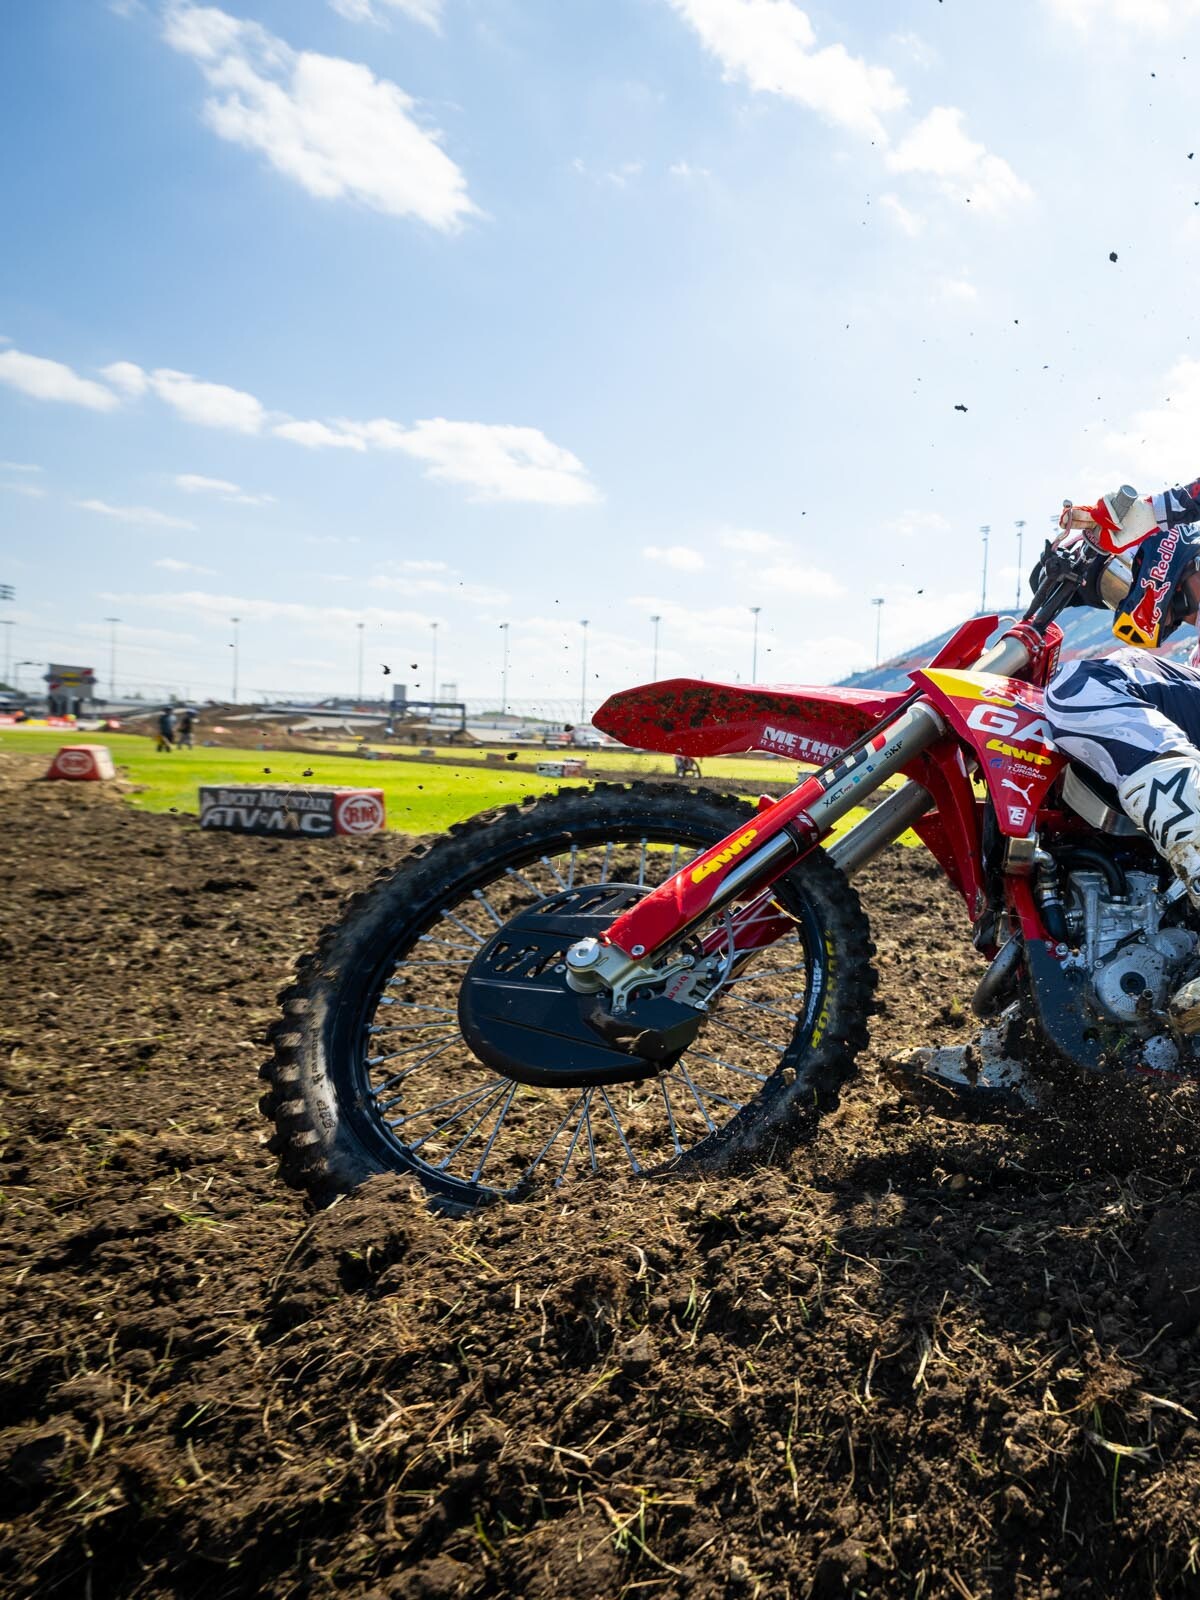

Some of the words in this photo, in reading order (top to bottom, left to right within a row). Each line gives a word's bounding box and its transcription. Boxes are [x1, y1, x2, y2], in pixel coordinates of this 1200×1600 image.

[1149, 547, 1175, 582] Red
[762, 726, 846, 759] METHO
[884, 741, 903, 759] SKF
[1008, 765, 1048, 781] TURISMO
[1014, 763, 1041, 774] GRAN
[823, 788, 845, 808] XACT
[668, 975, 689, 1000] brem
